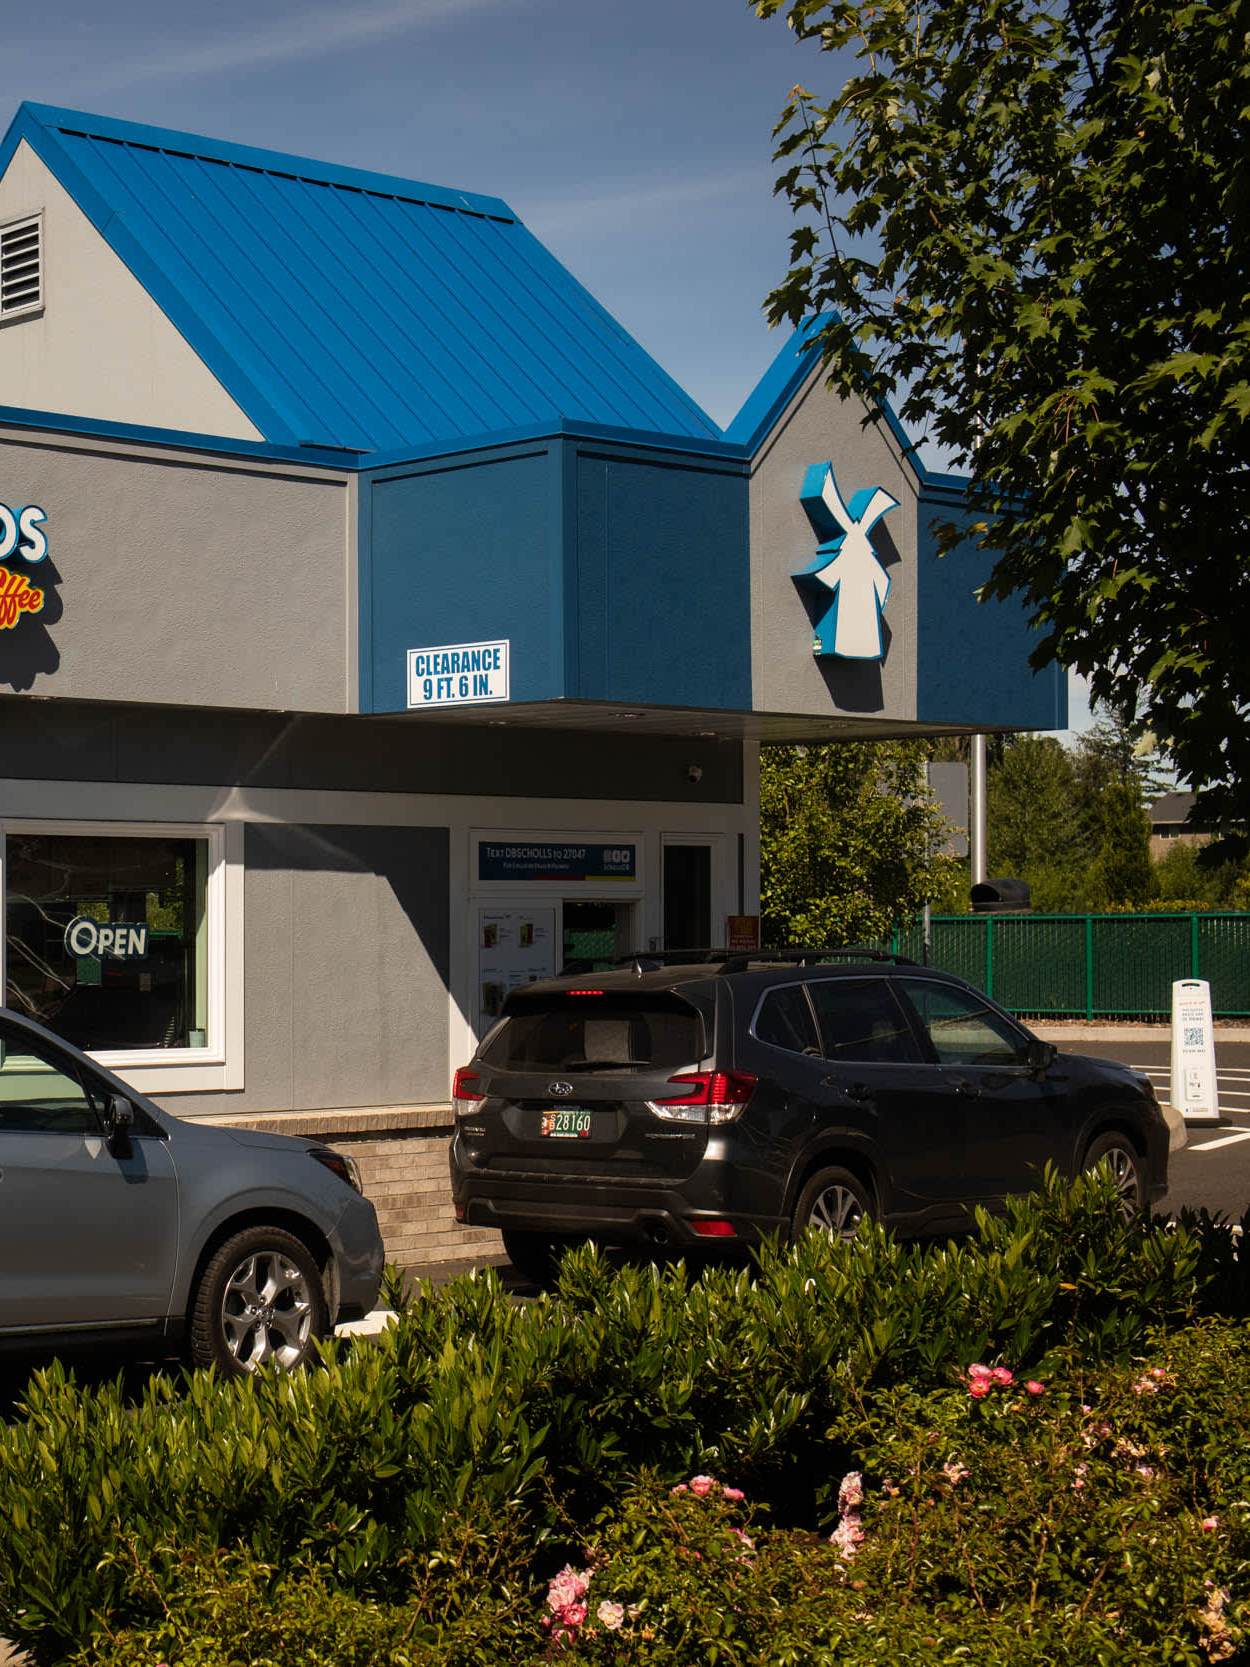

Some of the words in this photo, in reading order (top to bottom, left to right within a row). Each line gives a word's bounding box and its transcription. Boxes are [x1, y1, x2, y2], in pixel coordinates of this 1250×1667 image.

[415, 648, 501, 677] CLEARANCE
[423, 678, 433, 700] 9
[437, 676, 455, 699] FT.
[459, 675, 469, 698] 6
[473, 673, 493, 697] IN.
[555, 1114, 591, 1132] 28160
